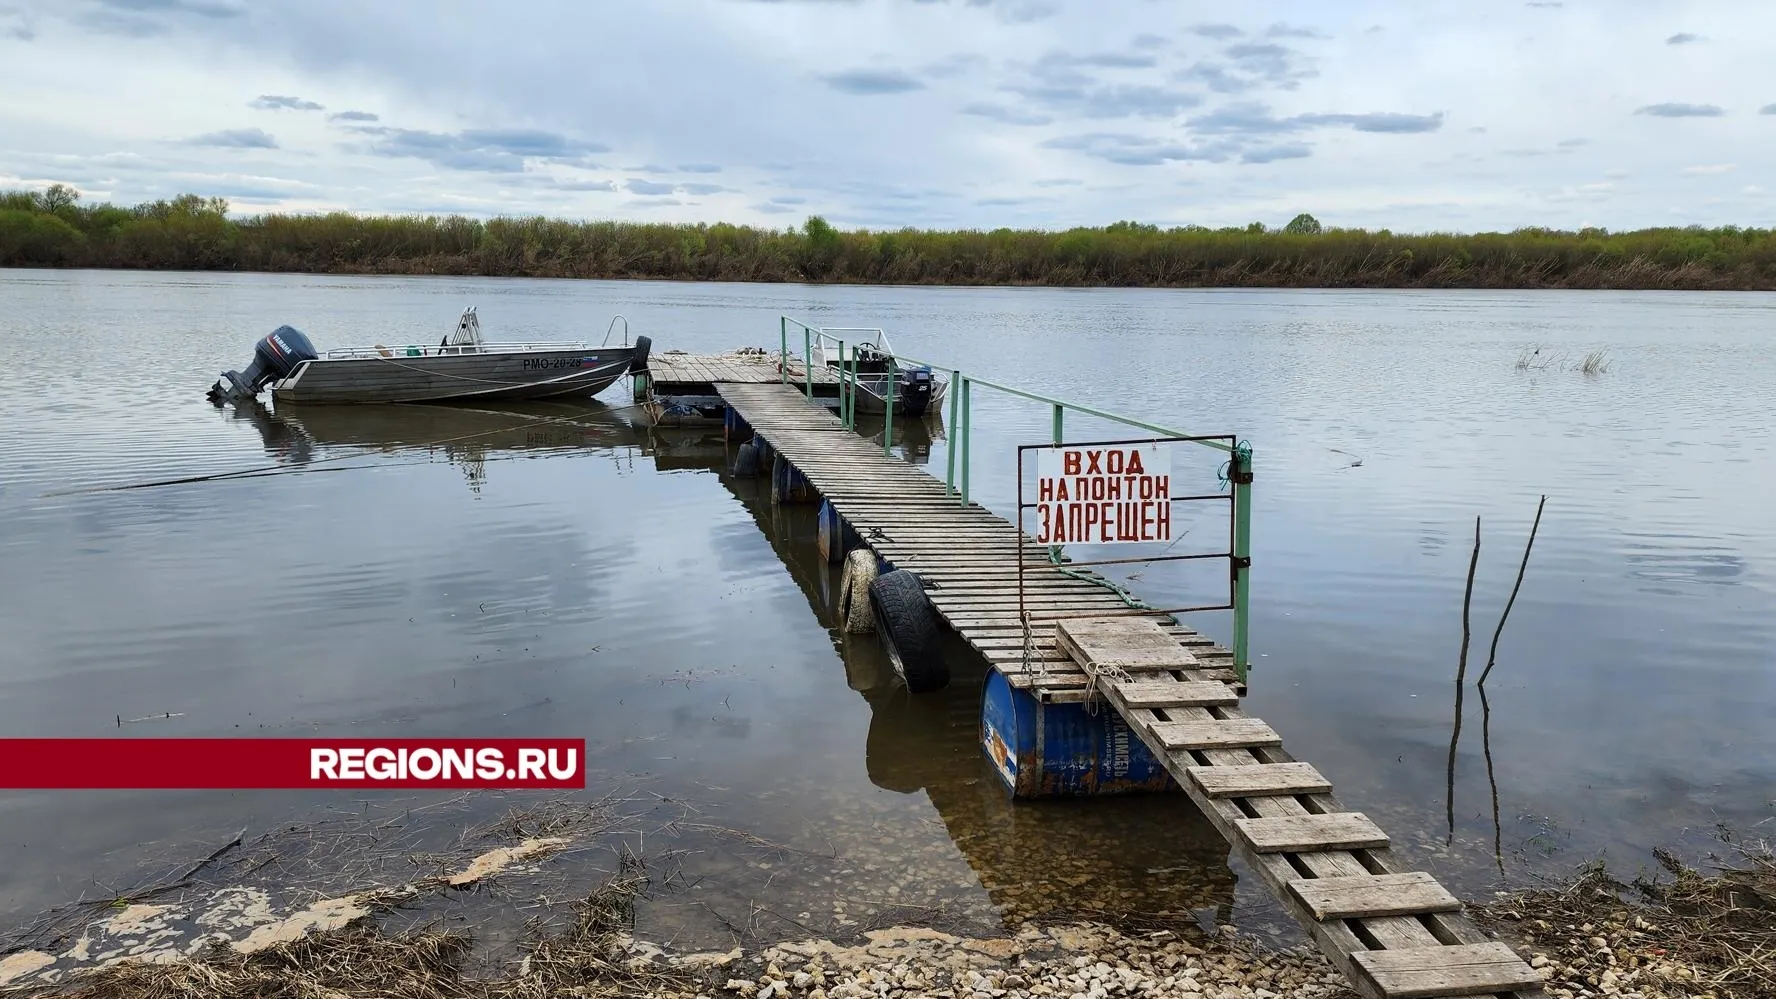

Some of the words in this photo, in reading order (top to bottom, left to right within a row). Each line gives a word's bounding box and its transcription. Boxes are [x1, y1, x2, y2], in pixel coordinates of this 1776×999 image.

[272, 334, 292, 354] YAMAHA
[1064, 450, 1144, 475] ВХОД
[1040, 477, 1069, 502] НА
[1075, 475, 1169, 500] ПОНТОН
